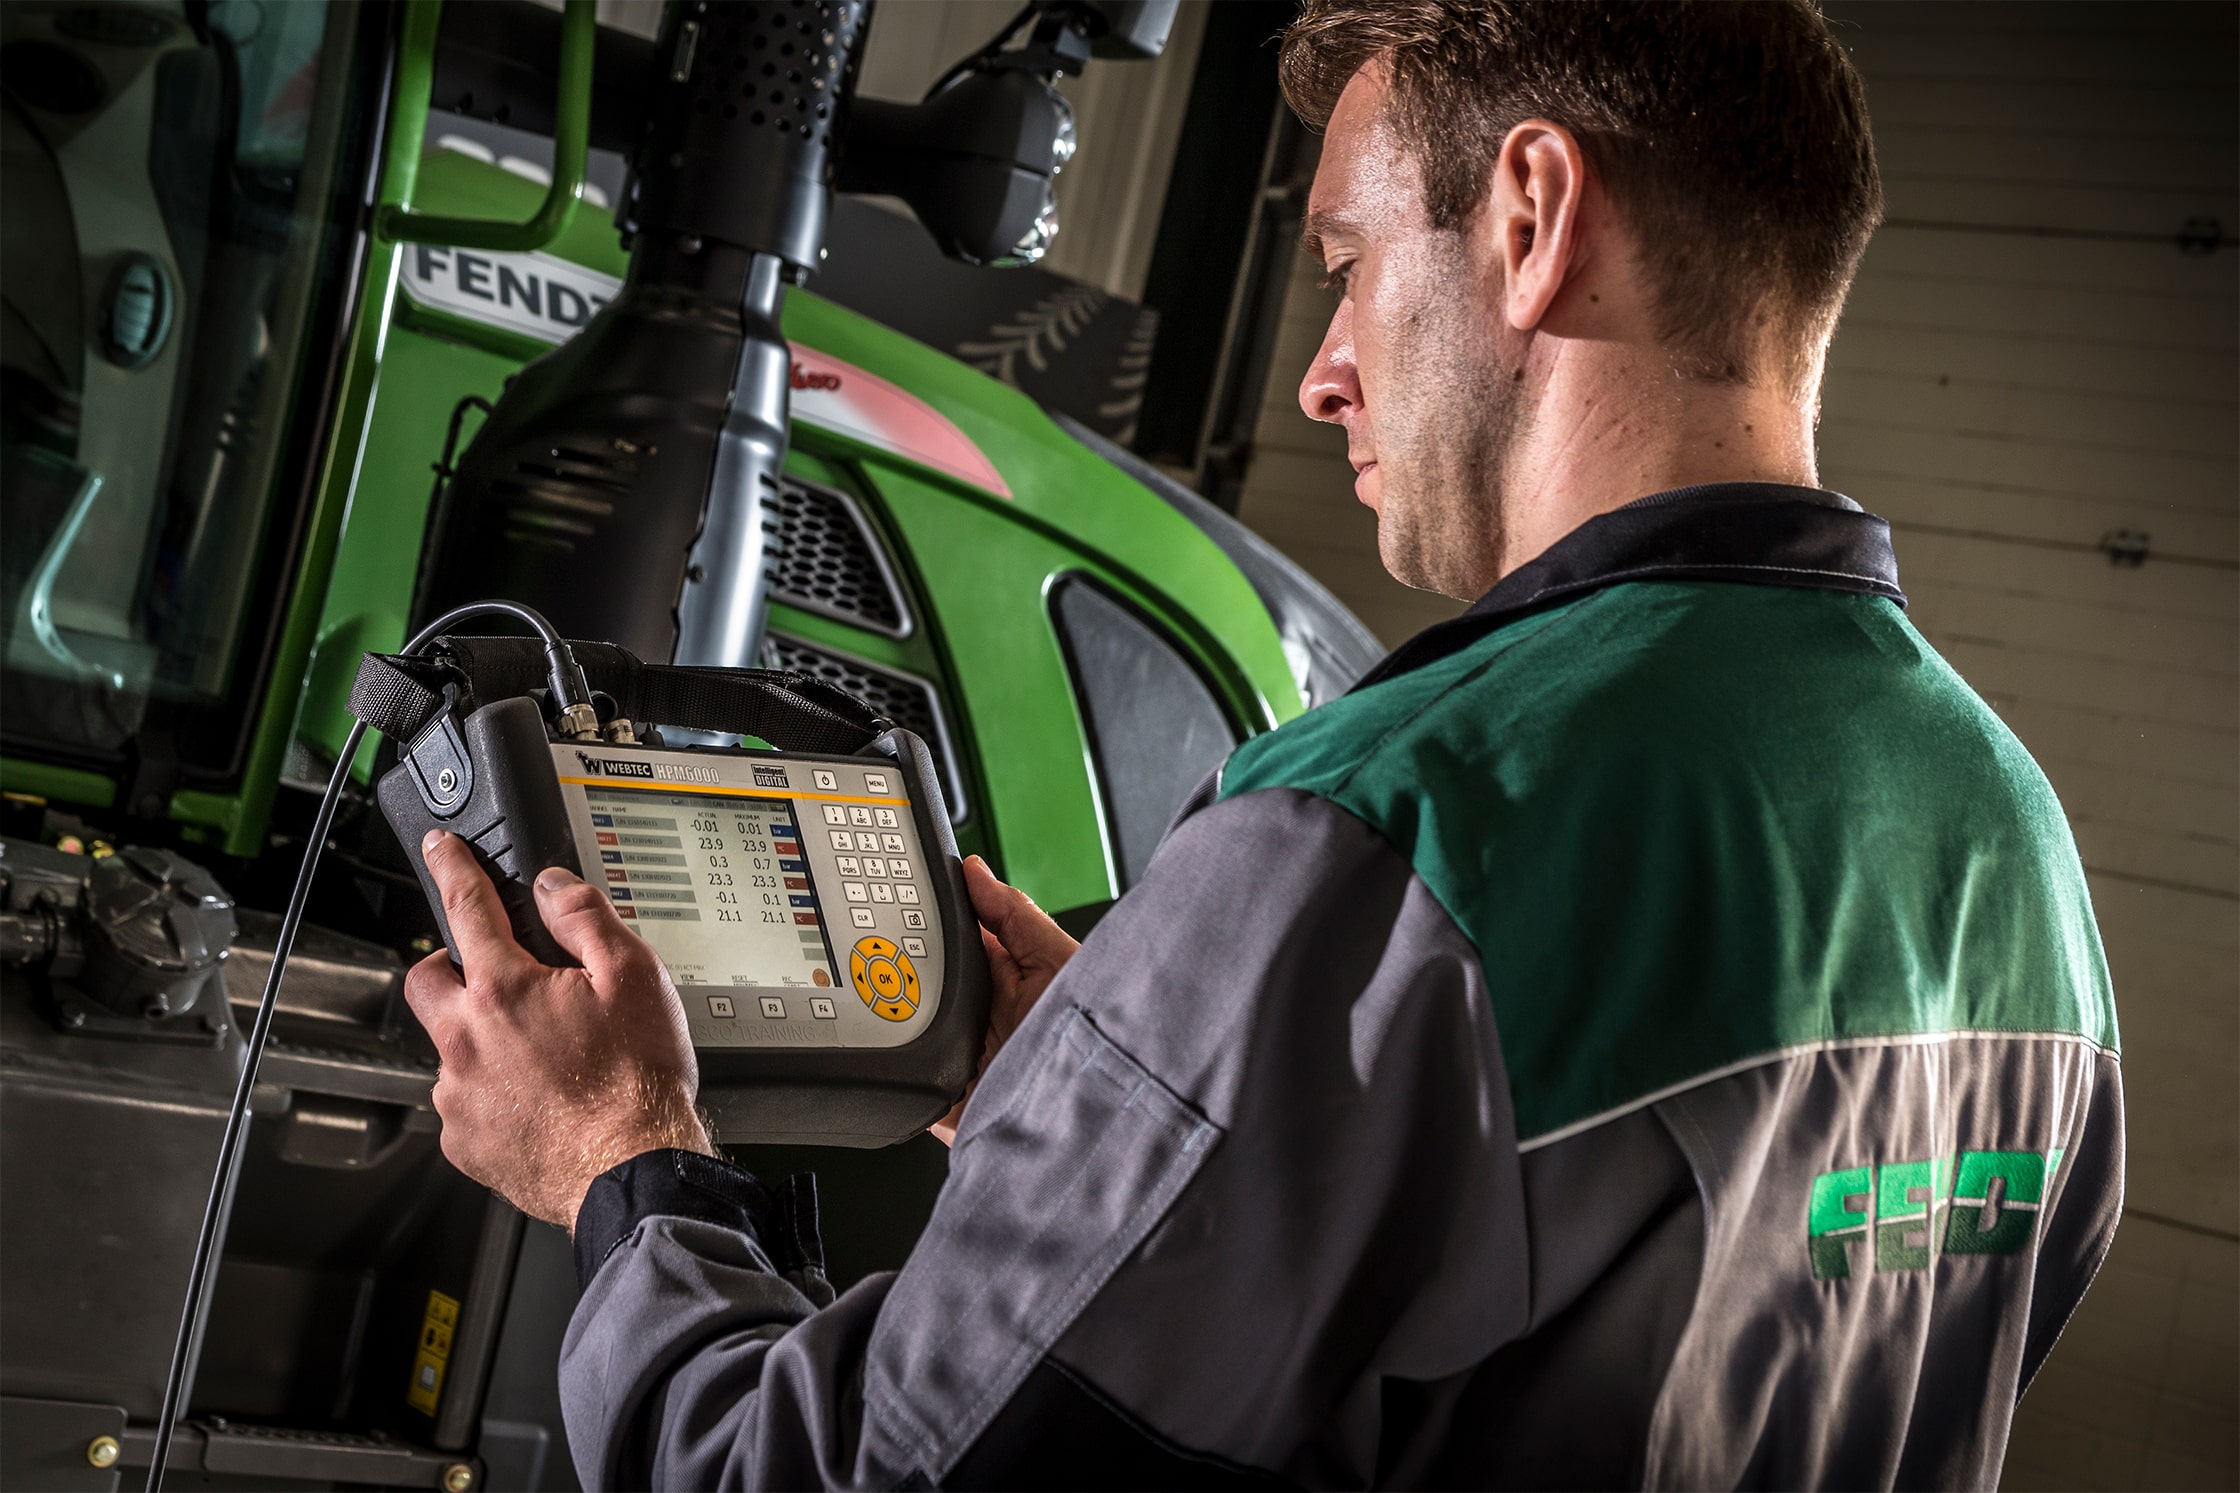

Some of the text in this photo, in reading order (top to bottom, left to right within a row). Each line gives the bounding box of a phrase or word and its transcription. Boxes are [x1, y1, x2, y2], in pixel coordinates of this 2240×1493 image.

[416, 244, 608, 326] FEND
[605, 761, 651, 776] WEBTEC
[655, 763, 720, 784] HPM6000
[753, 766, 785, 777] Intelligent
[755, 775, 788, 787] DIGITAL
[857, 809, 863, 817] 2
[690, 819, 720, 832] -0.01
[737, 822, 763, 835] 0.01
[838, 833, 844, 841] 4
[698, 837, 724, 850] 23.9
[742, 839, 767, 852] 23.9
[709, 855, 729, 868] 0.3
[753, 857, 771, 870] 0.7
[844, 858, 850, 866] 7
[871, 859, 877, 868] 8
[707, 873, 733, 886] 23.3
[751, 875, 777, 888] 23.3
[878, 885, 884, 893] 0
[715, 891, 738, 904] -0.1
[762, 893, 781, 905] 0.1
[717, 909, 743, 922] 21.1
[761, 911, 786, 923] 21.1
[878, 973, 893, 984] OK
[716, 1002, 728, 1011] F2
[768, 1003, 779, 1012] F3
[819, 1004, 829, 1013] F4
[740, 1022, 816, 1042] TRAINING
